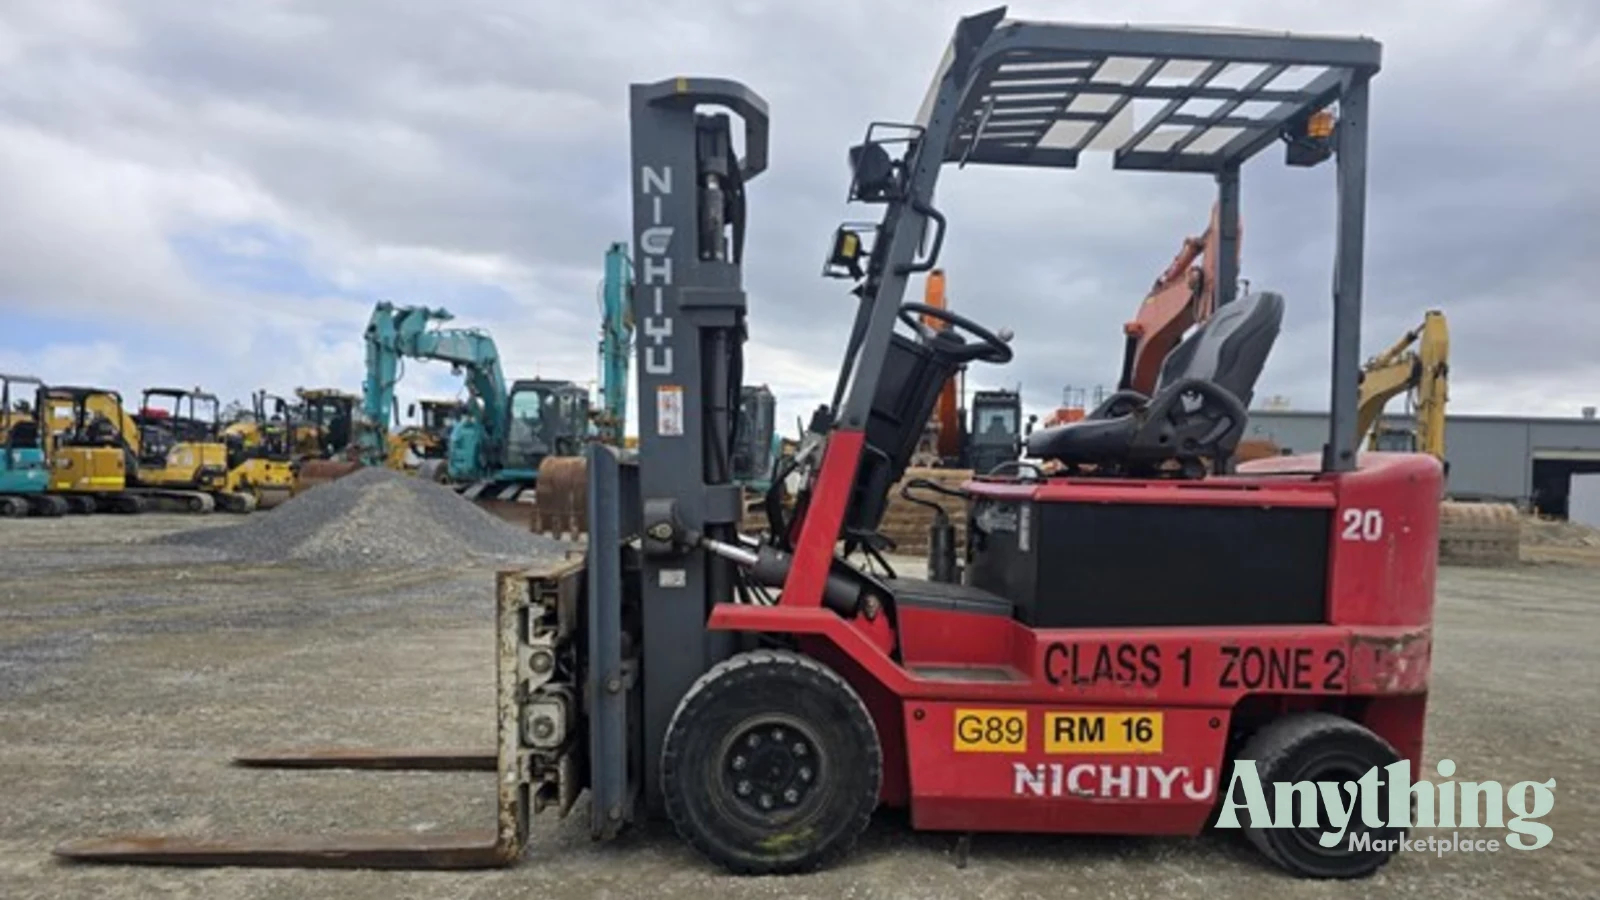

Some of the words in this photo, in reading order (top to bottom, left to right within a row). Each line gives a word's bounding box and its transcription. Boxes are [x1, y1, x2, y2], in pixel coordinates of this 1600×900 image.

[641, 166, 674, 374] NICHIYU
[1342, 508, 1383, 542] 20
[1044, 642, 1161, 687] CLASS
[1177, 648, 1192, 687] 1
[1219, 647, 1312, 690] ZONE
[1323, 649, 1345, 690] 2
[958, 717, 1024, 744] G89
[1054, 718, 1104, 742] RM
[1120, 718, 1153, 743] 16
[1013, 763, 1213, 800] NICHIYU
